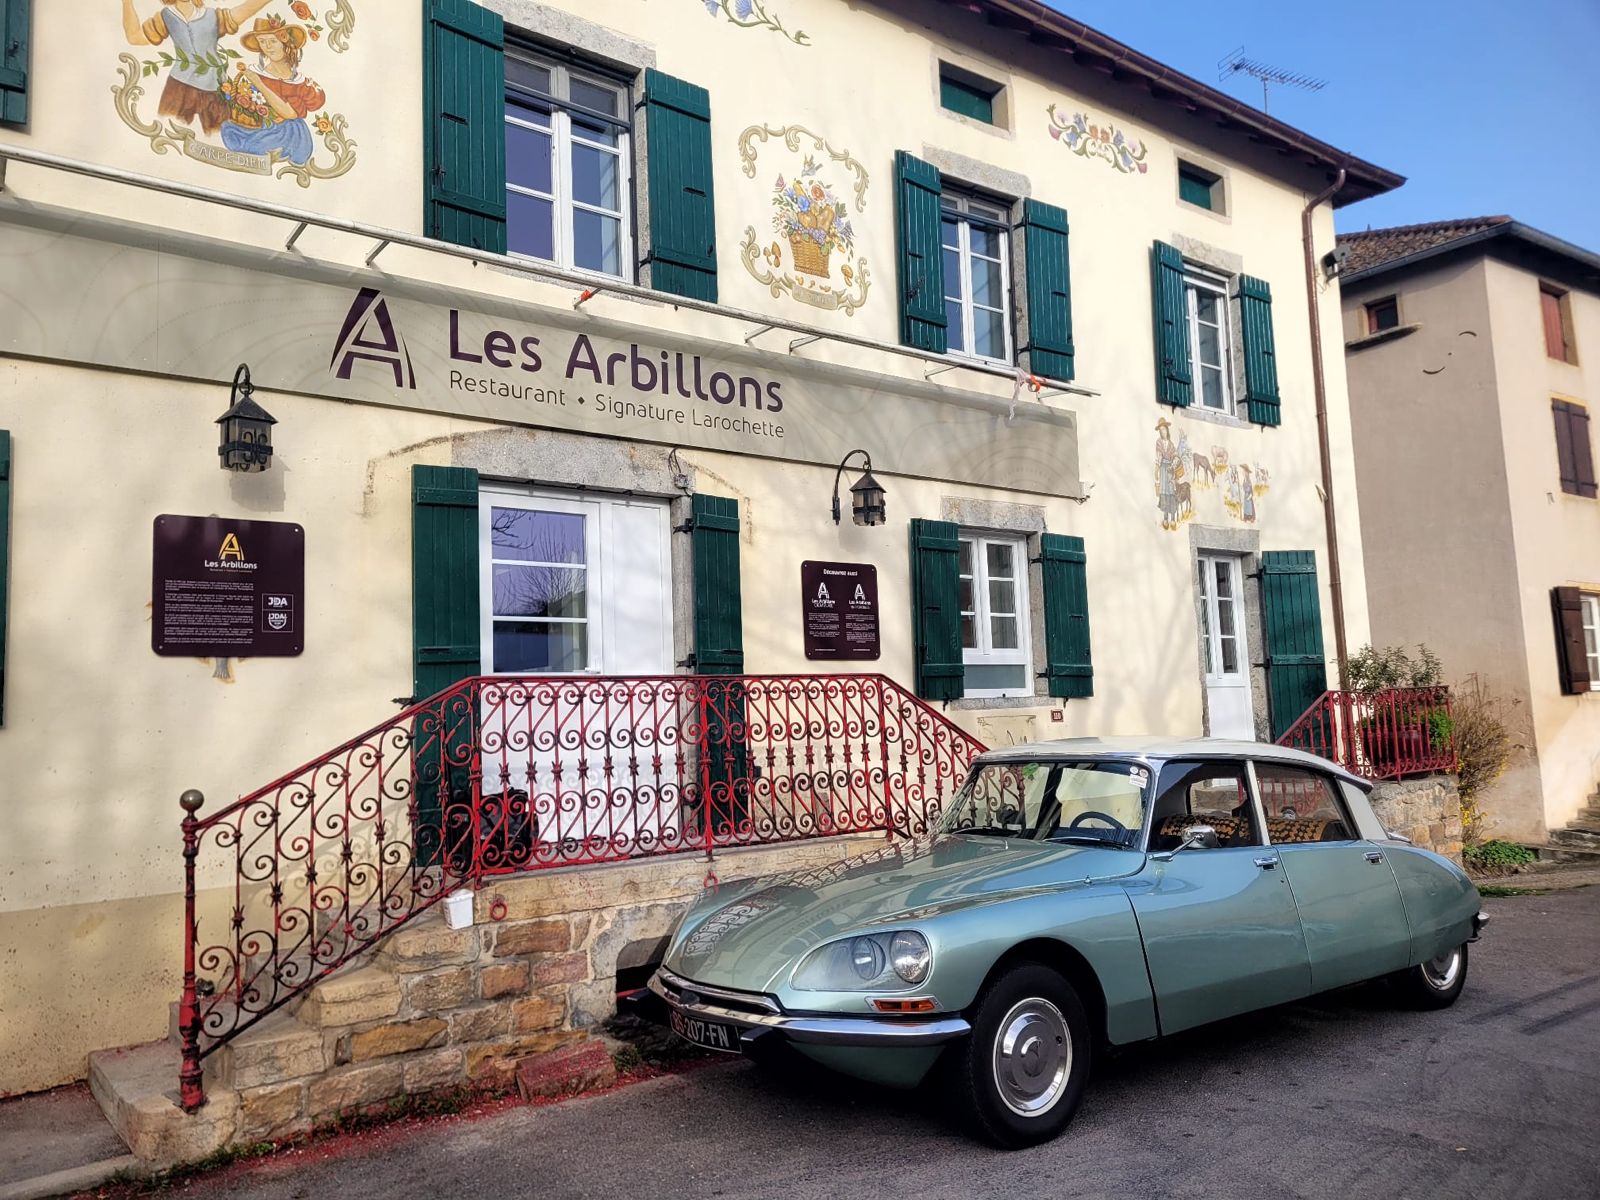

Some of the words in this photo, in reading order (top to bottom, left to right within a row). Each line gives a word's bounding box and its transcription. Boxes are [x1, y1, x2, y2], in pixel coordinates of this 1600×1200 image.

[449, 309, 543, 373] Les
[564, 333, 784, 413] Arbillons
[449, 370, 566, 406] Restaurant
[595, 394, 685, 424] Signature
[692, 409, 785, 438] Larochette
[204, 559, 219, 569] Les
[220, 560, 258, 570] Arbillons
